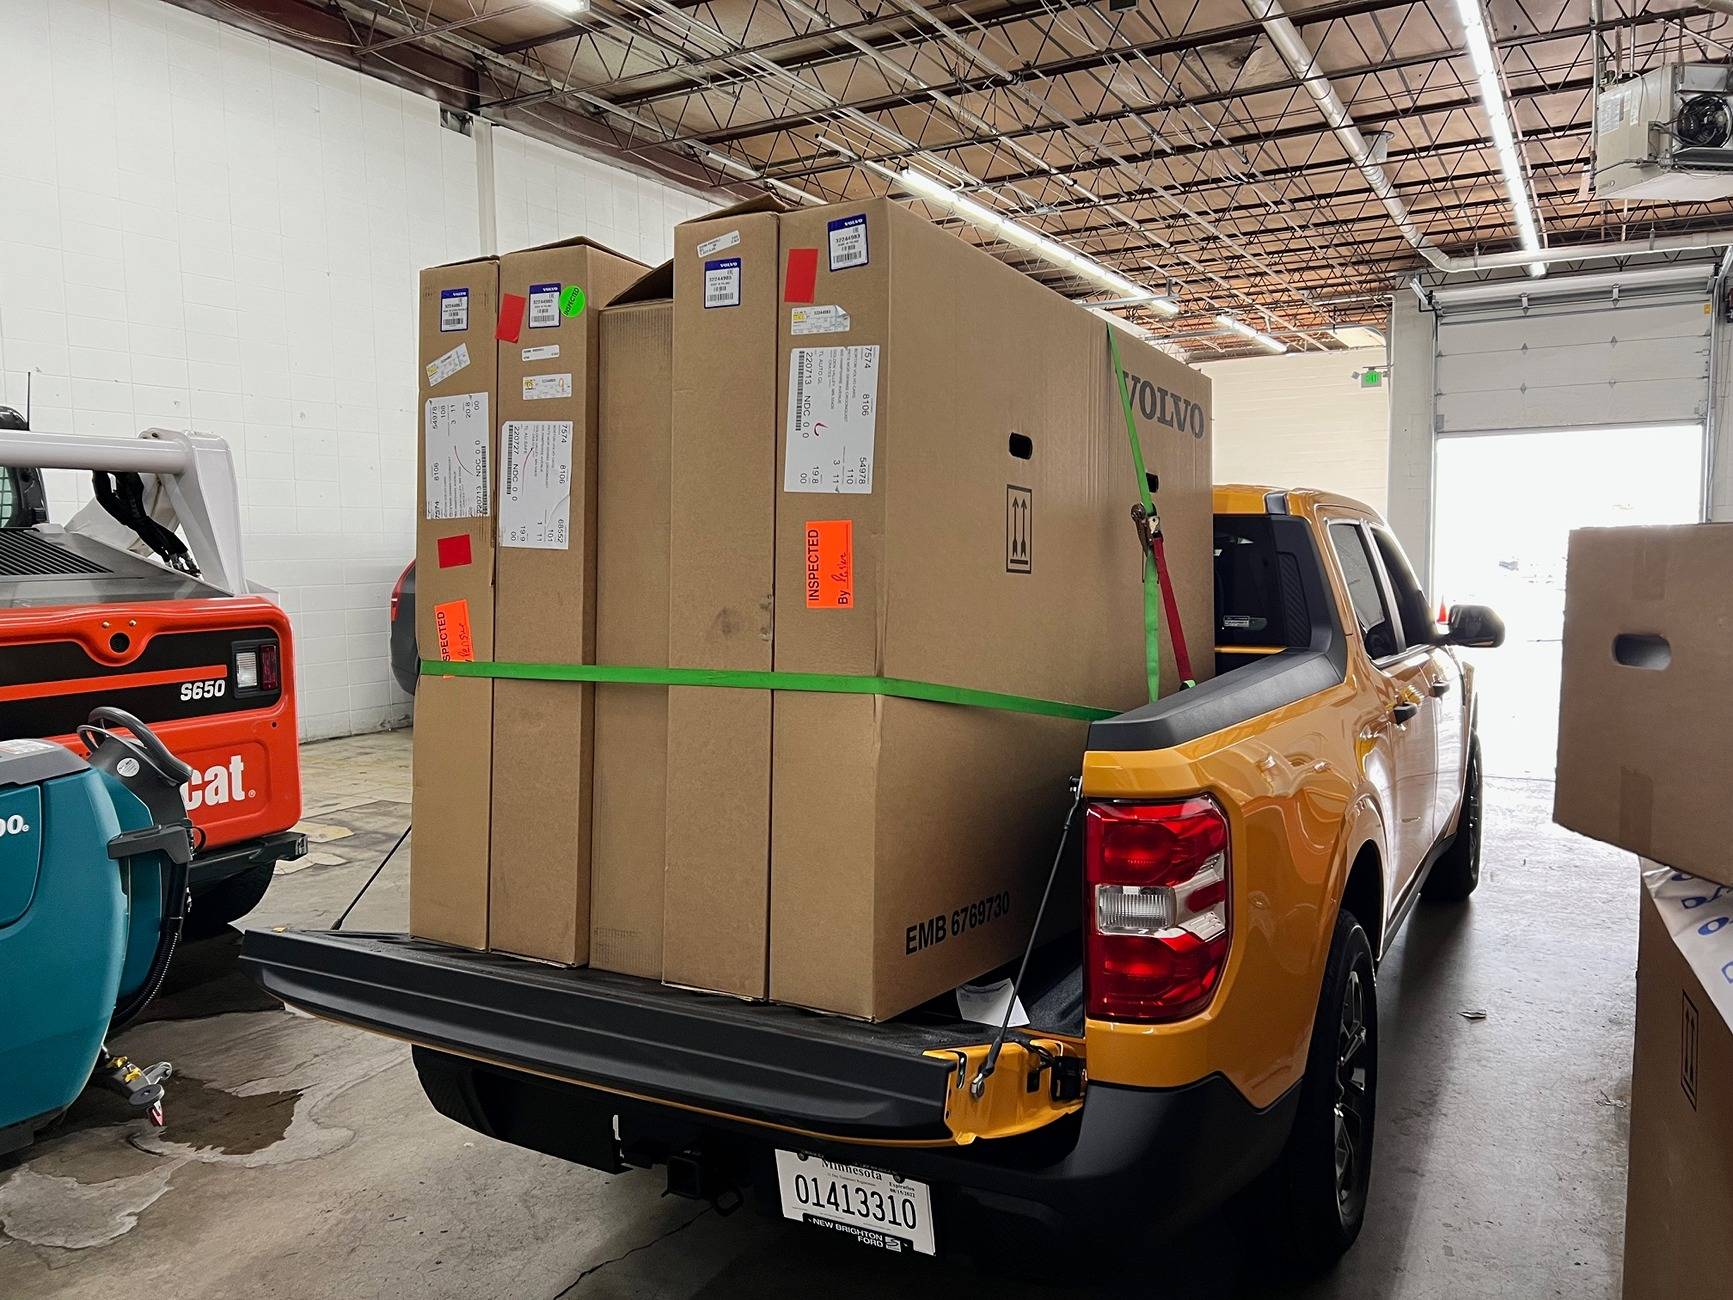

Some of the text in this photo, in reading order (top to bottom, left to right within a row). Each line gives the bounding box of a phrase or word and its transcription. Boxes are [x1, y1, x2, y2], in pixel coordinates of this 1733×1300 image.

[844, 218, 863, 226] VOLVO
[804, 352, 813, 385] 220713
[803, 395, 811, 416] NDC
[1115, 369, 1204, 439] VOLVO
[858, 347, 873, 485] 7574 8106 54978
[560, 424, 568, 443] 7574
[799, 472, 808, 484] 00
[832, 474, 839, 485] 11
[846, 469, 854, 485] 110
[807, 529, 820, 601] INSPECTED
[837, 590, 851, 605] By
[180, 679, 225, 701] S650
[905, 890, 1010, 956] EMB 6769730
[821, 1160, 883, 1181] Minnesota
[794, 1174, 917, 1230] 01413310
[812, 1217, 834, 1229] NEW
[835, 1223, 884, 1241] BRIGHTON
[857, 1235, 884, 1248] FORD
